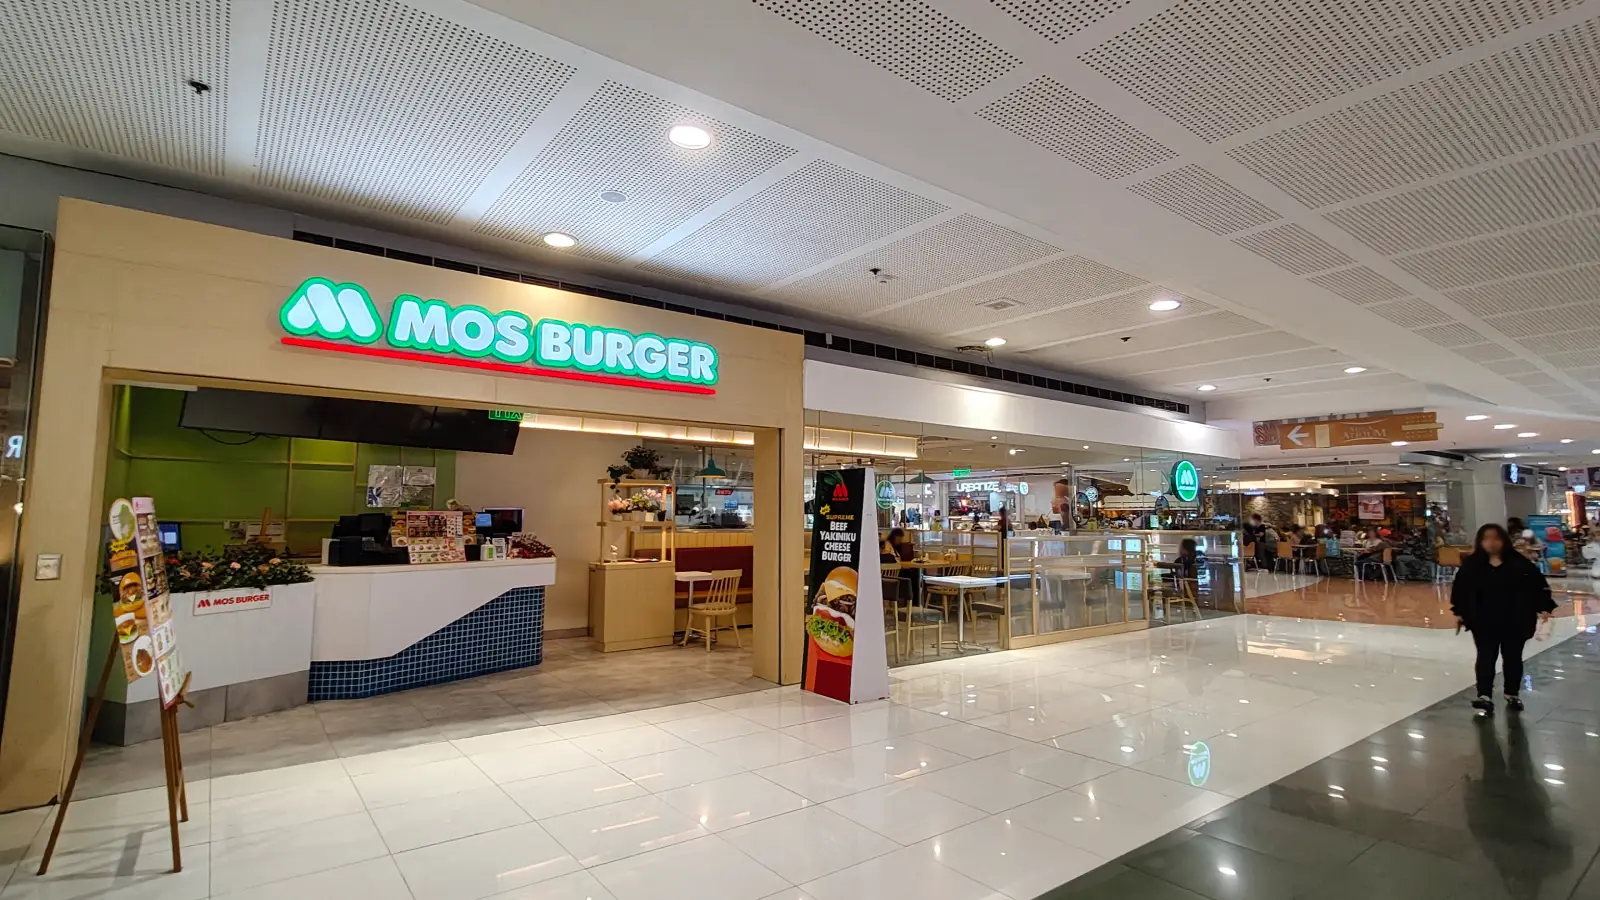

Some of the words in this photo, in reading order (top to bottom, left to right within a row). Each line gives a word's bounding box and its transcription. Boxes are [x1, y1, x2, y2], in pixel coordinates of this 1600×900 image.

[394, 300, 529, 358] MOS
[541, 322, 715, 381] BURGER
[956, 481, 1002, 493] URBANIZE
[830, 521, 848, 531] BEEF
[820, 531, 857, 542] YAKINIKU
[824, 542, 851, 552] CHEESE
[821, 551, 852, 562] BURGER
[213, 597, 235, 606] MOS
[235, 594, 270, 604] BURGER
